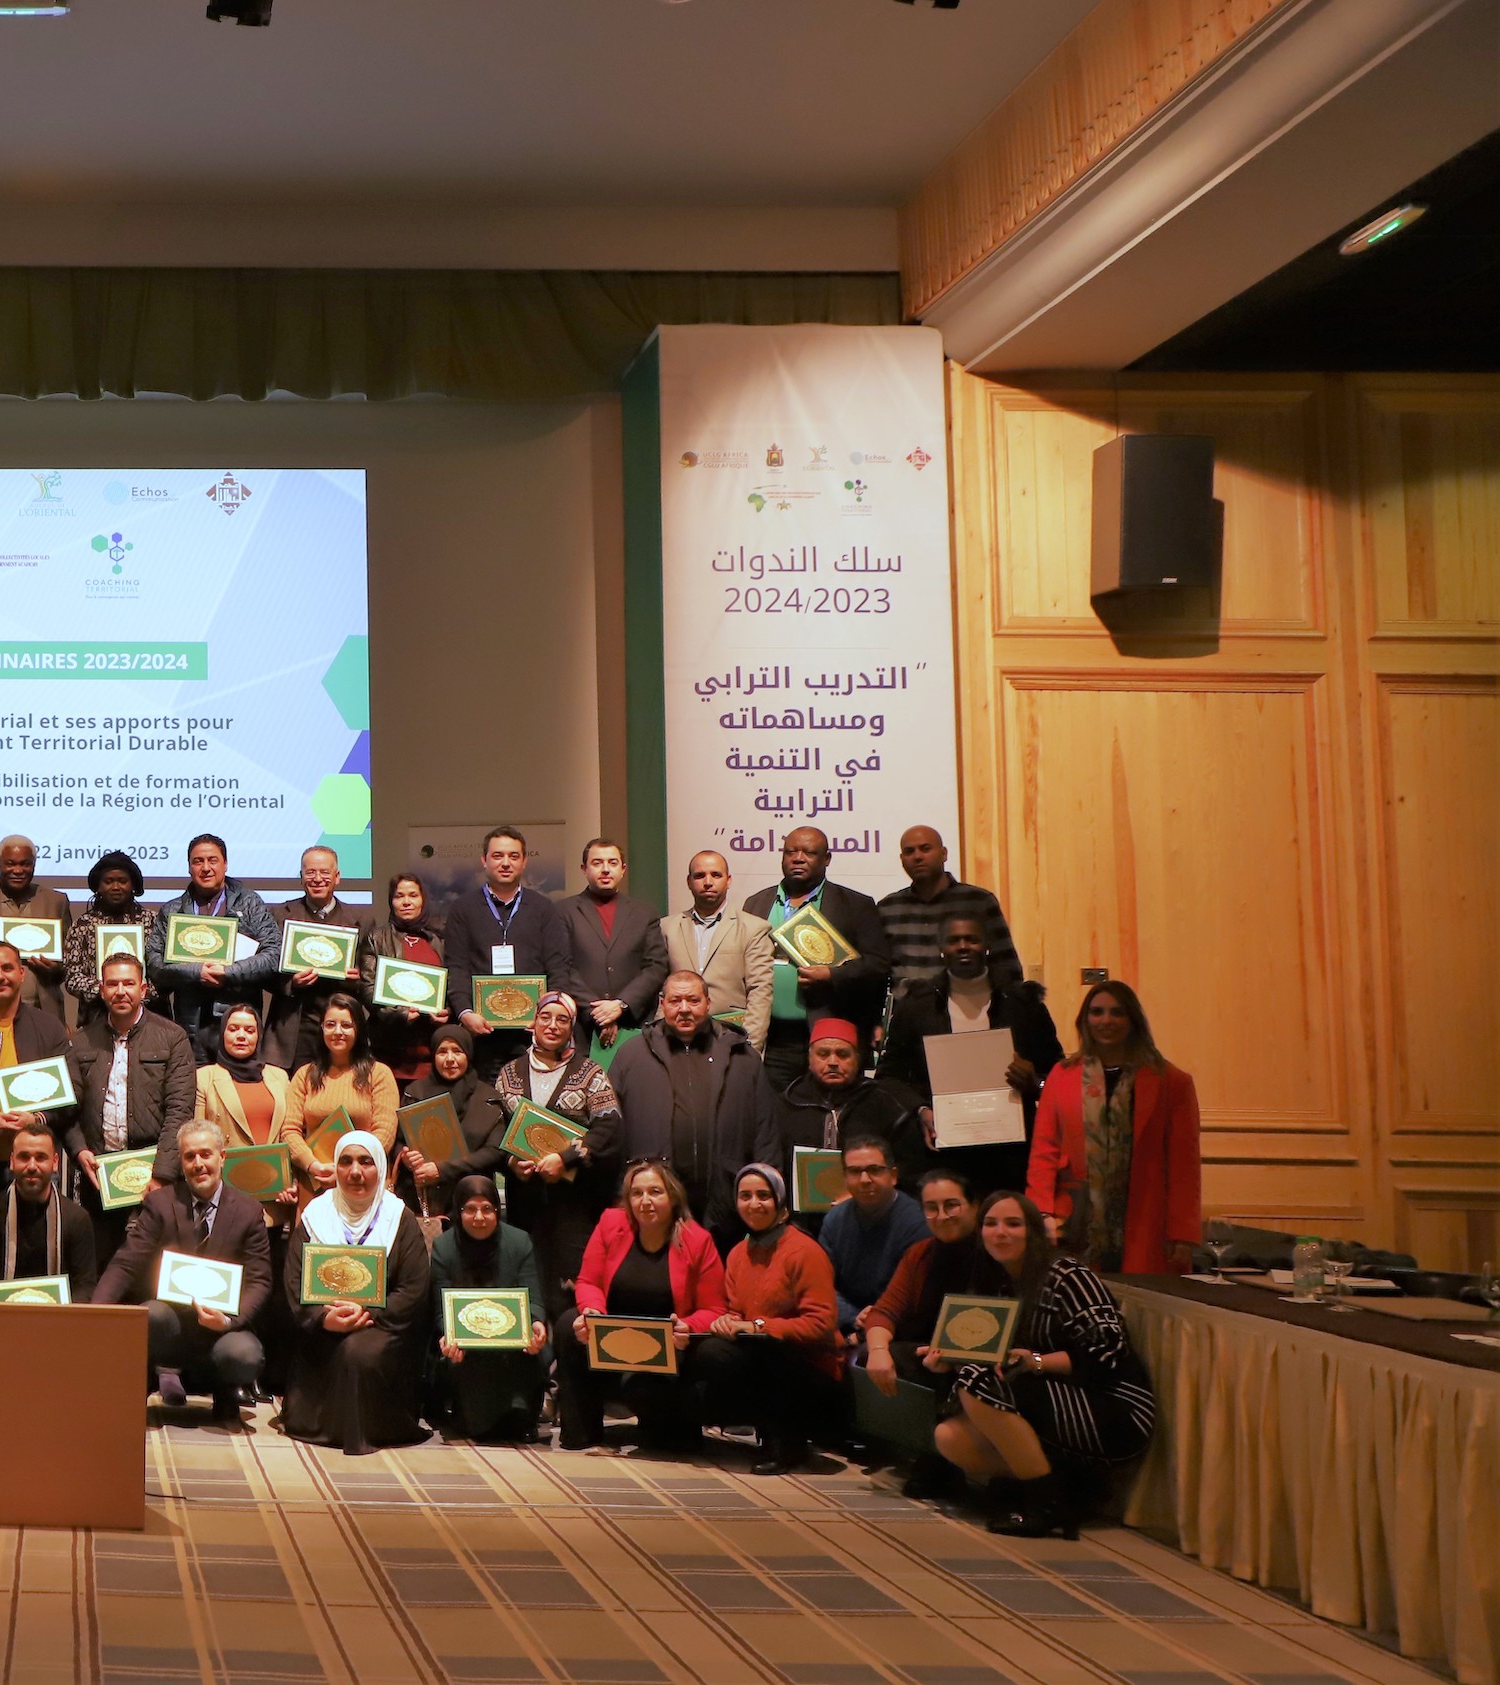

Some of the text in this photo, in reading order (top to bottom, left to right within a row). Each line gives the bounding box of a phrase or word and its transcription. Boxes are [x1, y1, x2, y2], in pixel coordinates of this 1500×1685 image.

[132, 487, 168, 497] Echos
[711, 546, 901, 579] سلك الندوات
[84, 578, 141, 586] COACHING
[725, 588, 890, 613] 2024/2023
[84, 653, 188, 670] 2023/2024
[695, 666, 789, 702] الترابي
[805, 667, 906, 696] التدريب
[40, 715, 59, 728] et
[66, 718, 96, 728] ses
[103, 716, 180, 735] apports
[188, 718, 233, 734] pour
[719, 707, 884, 736] ومساهماته
[19, 735, 120, 750] Territorial
[129, 736, 207, 750] Durable
[726, 747, 880, 784] في التنمية
[95, 776, 112, 788] et
[118, 774, 139, 788] de
[146, 775, 238, 789] formation
[53, 793, 73, 807] de
[81, 793, 95, 807] la
[103, 793, 163, 811] Région
[170, 794, 192, 807] de
[199, 794, 283, 808] l’Oriental
[754, 788, 853, 818] الترابية
[127, 846, 169, 860] 2023
